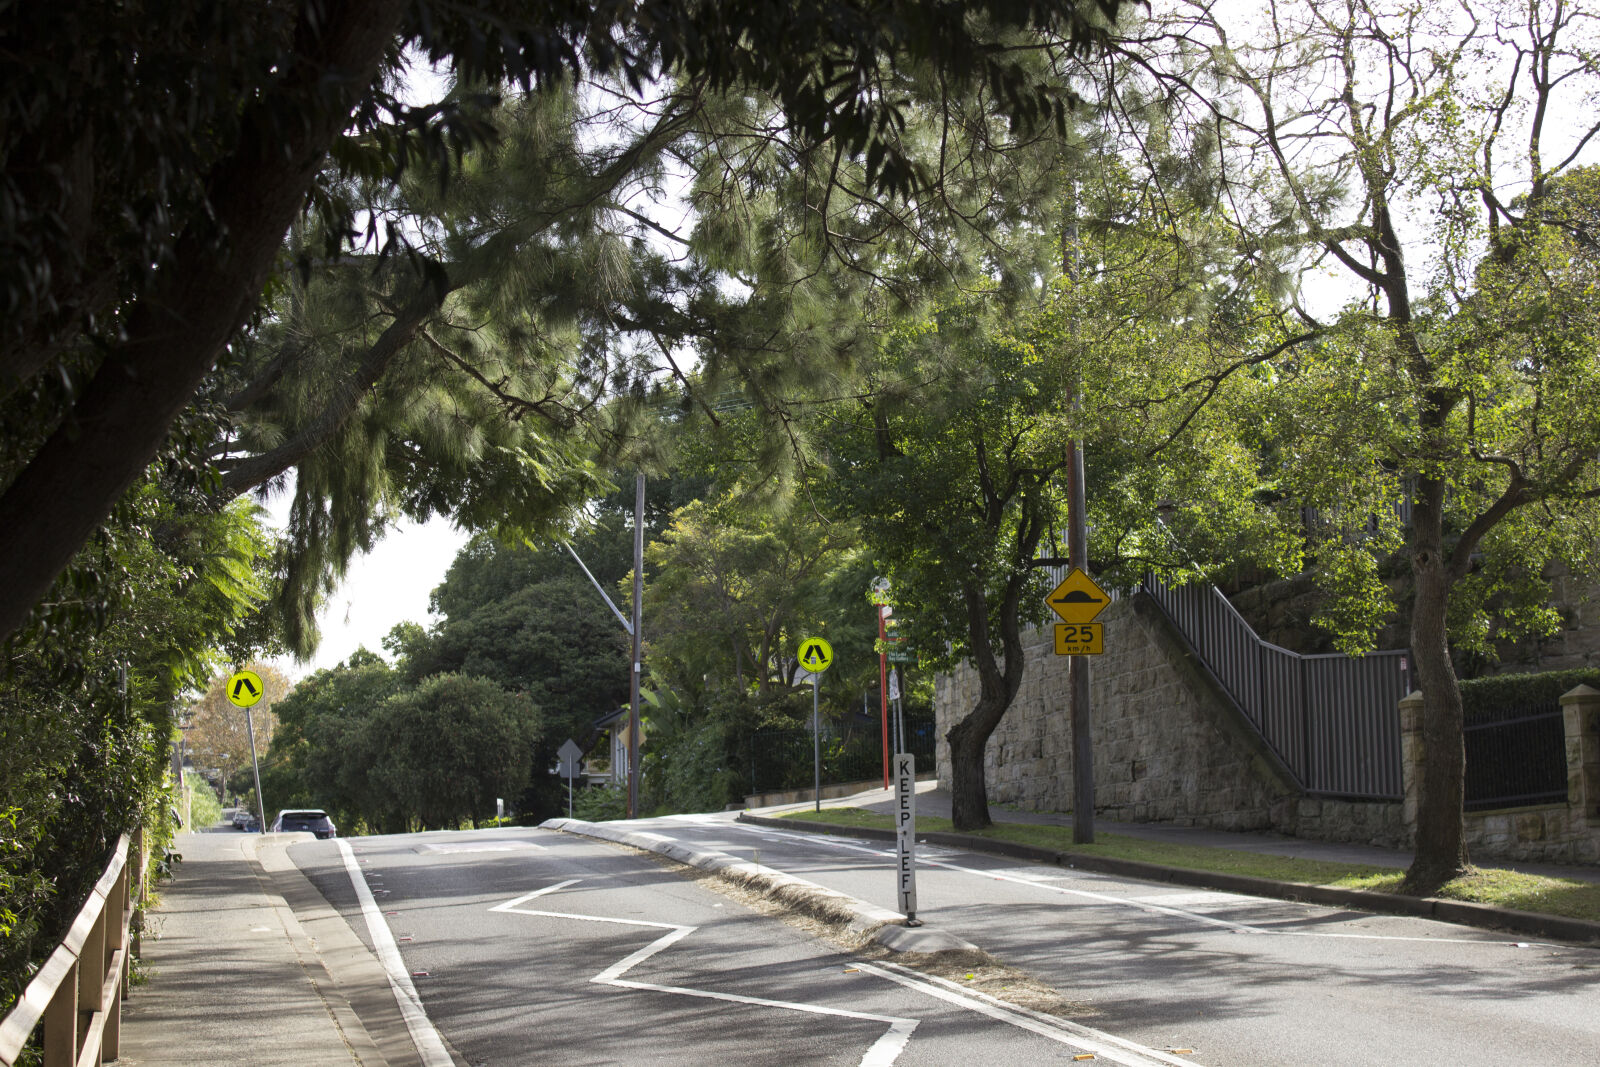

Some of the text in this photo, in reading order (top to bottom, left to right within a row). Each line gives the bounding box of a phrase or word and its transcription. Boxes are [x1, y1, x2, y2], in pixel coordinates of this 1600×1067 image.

[1064, 626, 1094, 643] 25
[1067, 645, 1091, 654] km/h
[899, 761, 911, 910] KEEP LEFT
